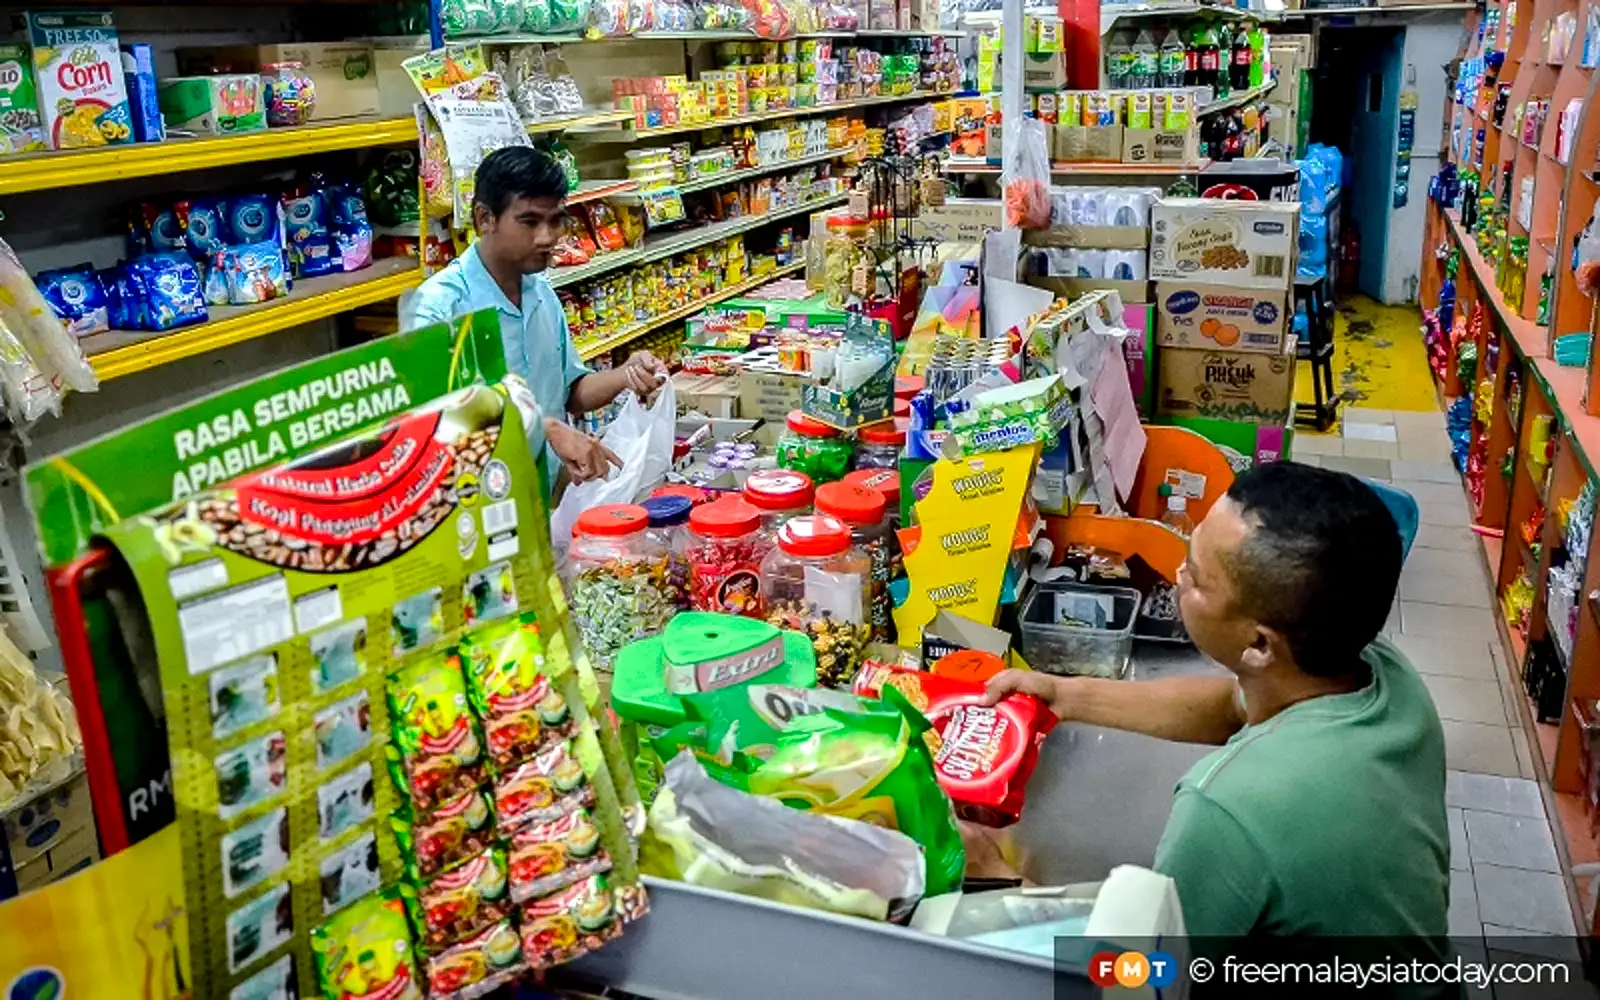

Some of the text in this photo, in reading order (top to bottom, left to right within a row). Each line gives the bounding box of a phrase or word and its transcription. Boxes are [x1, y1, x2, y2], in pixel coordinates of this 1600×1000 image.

[44, 29, 83, 45] FREE
[57, 61, 113, 91] Corn
[173, 357, 396, 460] RASA SEMPURNA
[172, 384, 411, 501] APABILA BERSAMA
[974, 424, 1028, 445] mentos
[708, 647, 779, 682] Extra
